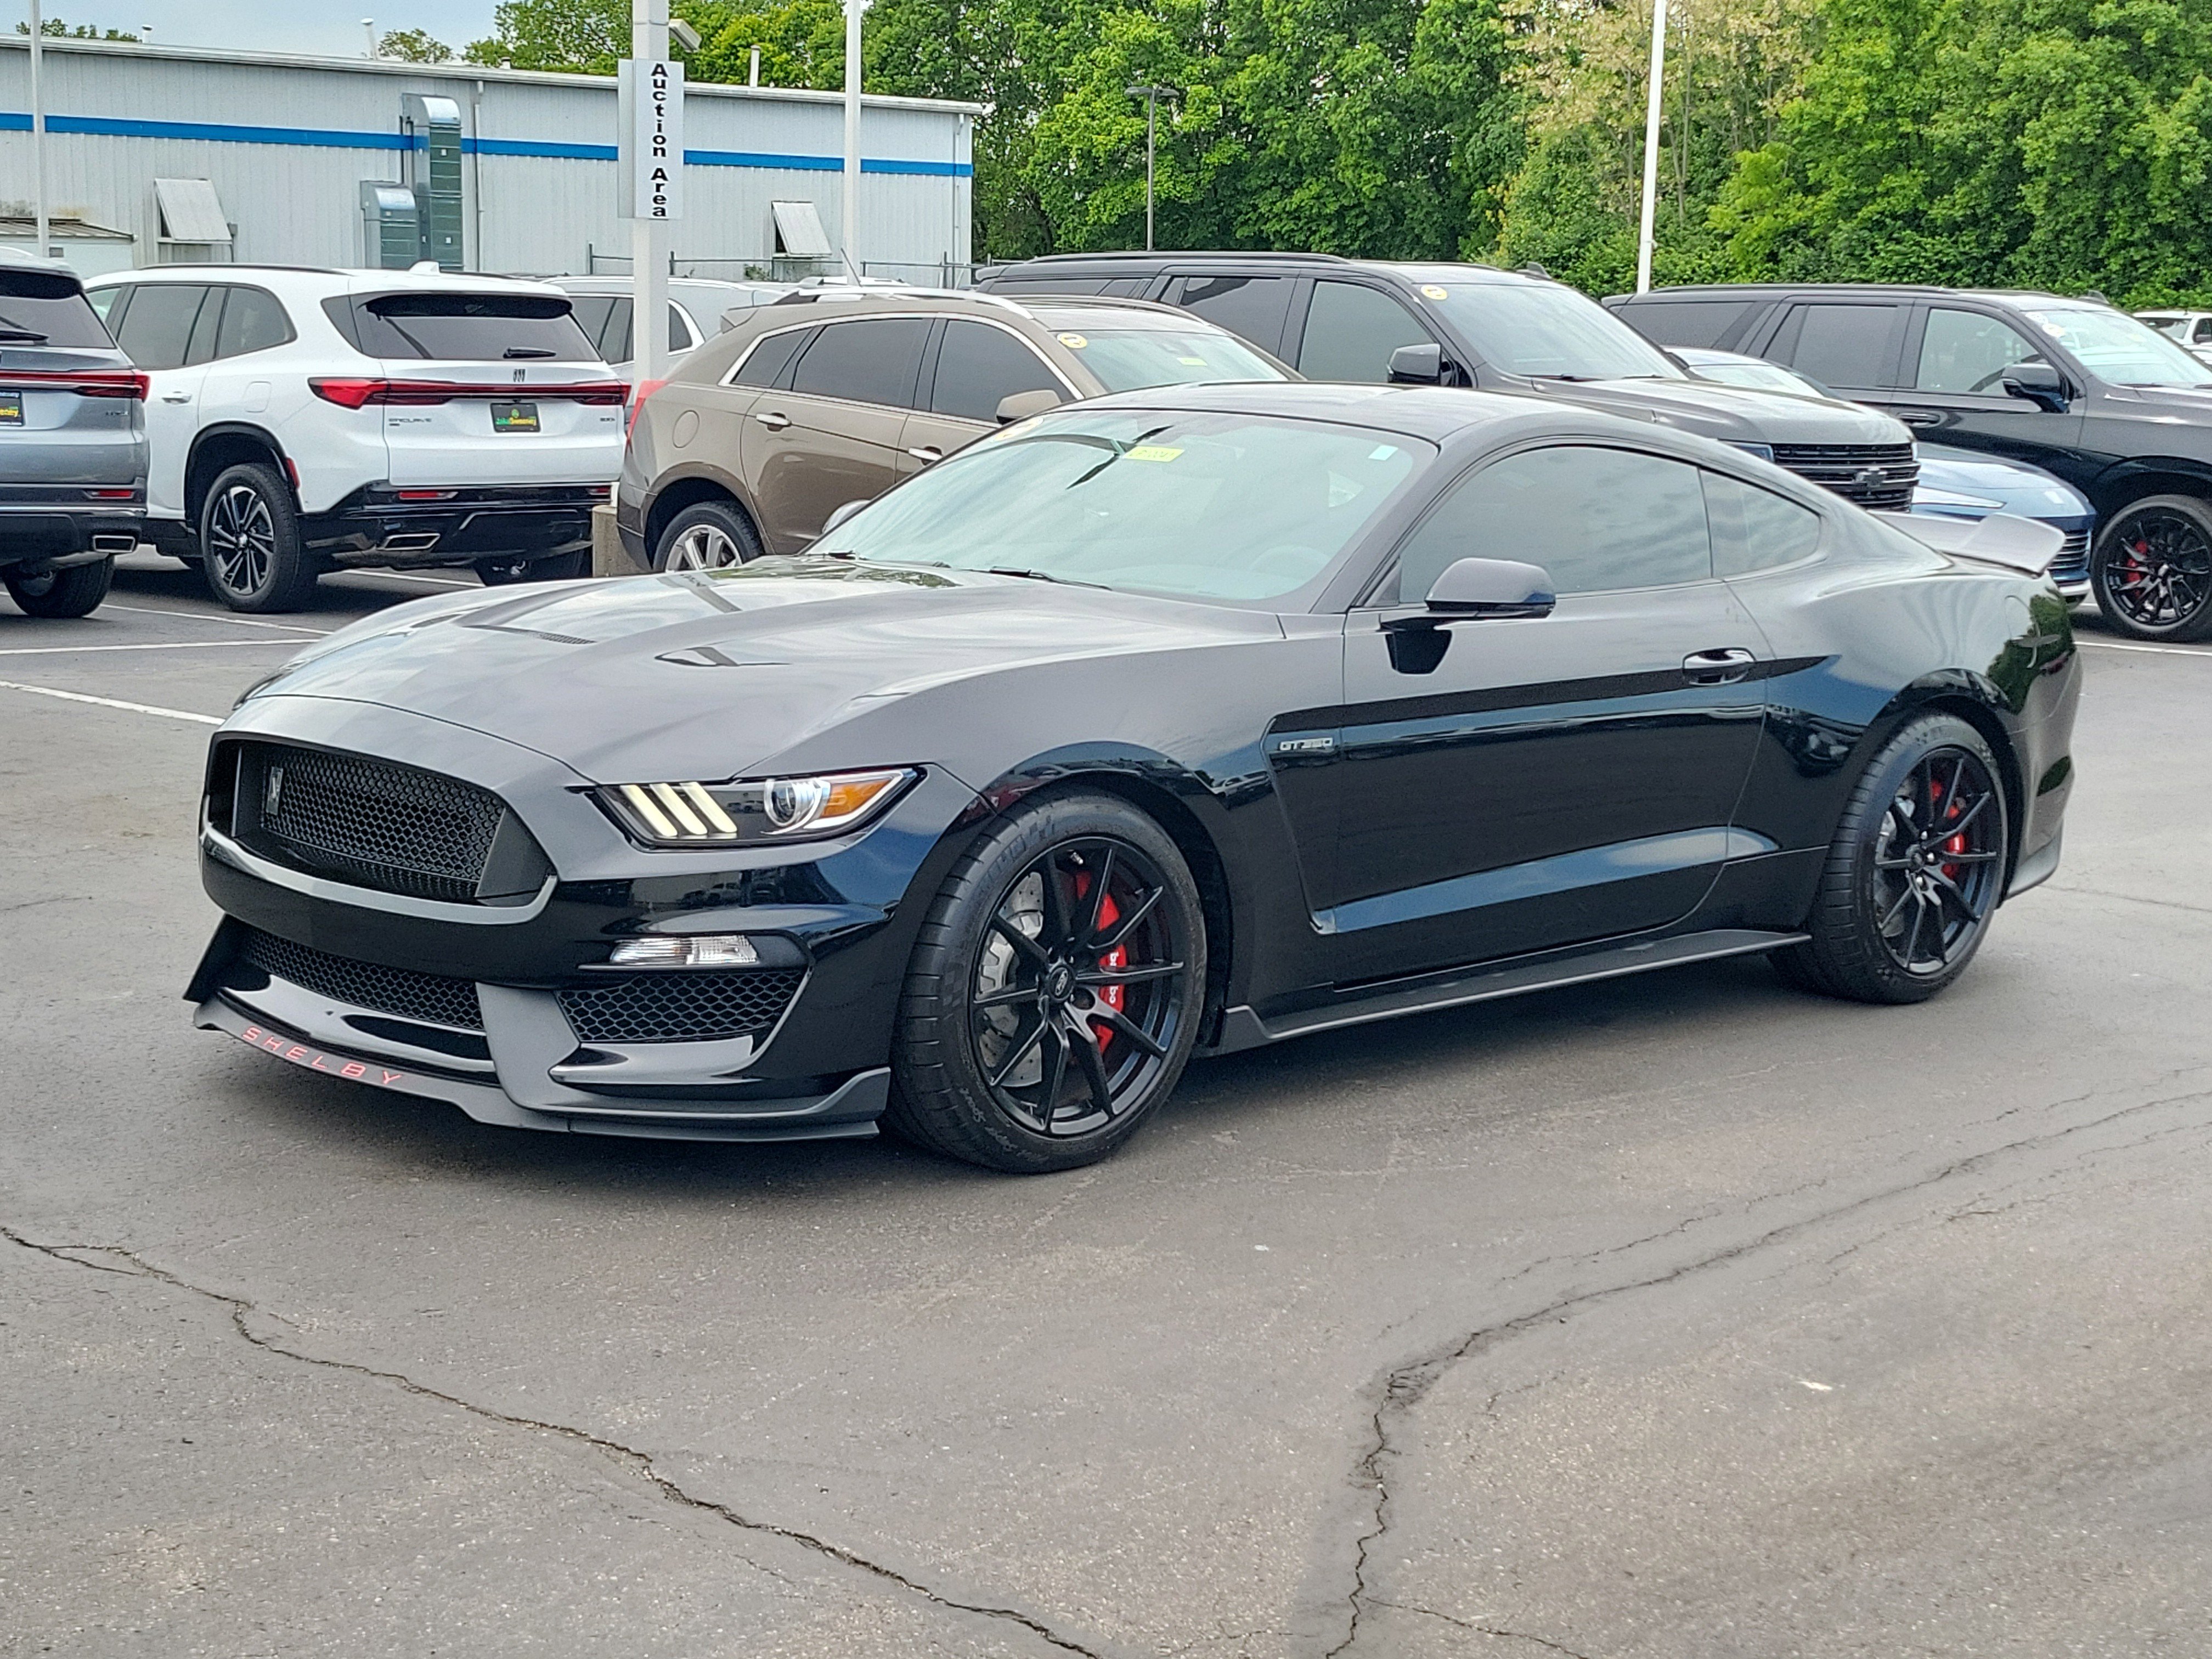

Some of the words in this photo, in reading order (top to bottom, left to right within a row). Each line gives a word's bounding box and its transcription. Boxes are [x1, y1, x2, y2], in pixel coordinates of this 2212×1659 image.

[651, 63, 668, 157] Auction
[651, 167, 668, 217] Area
[242, 1026, 402, 1084] SHELBY
